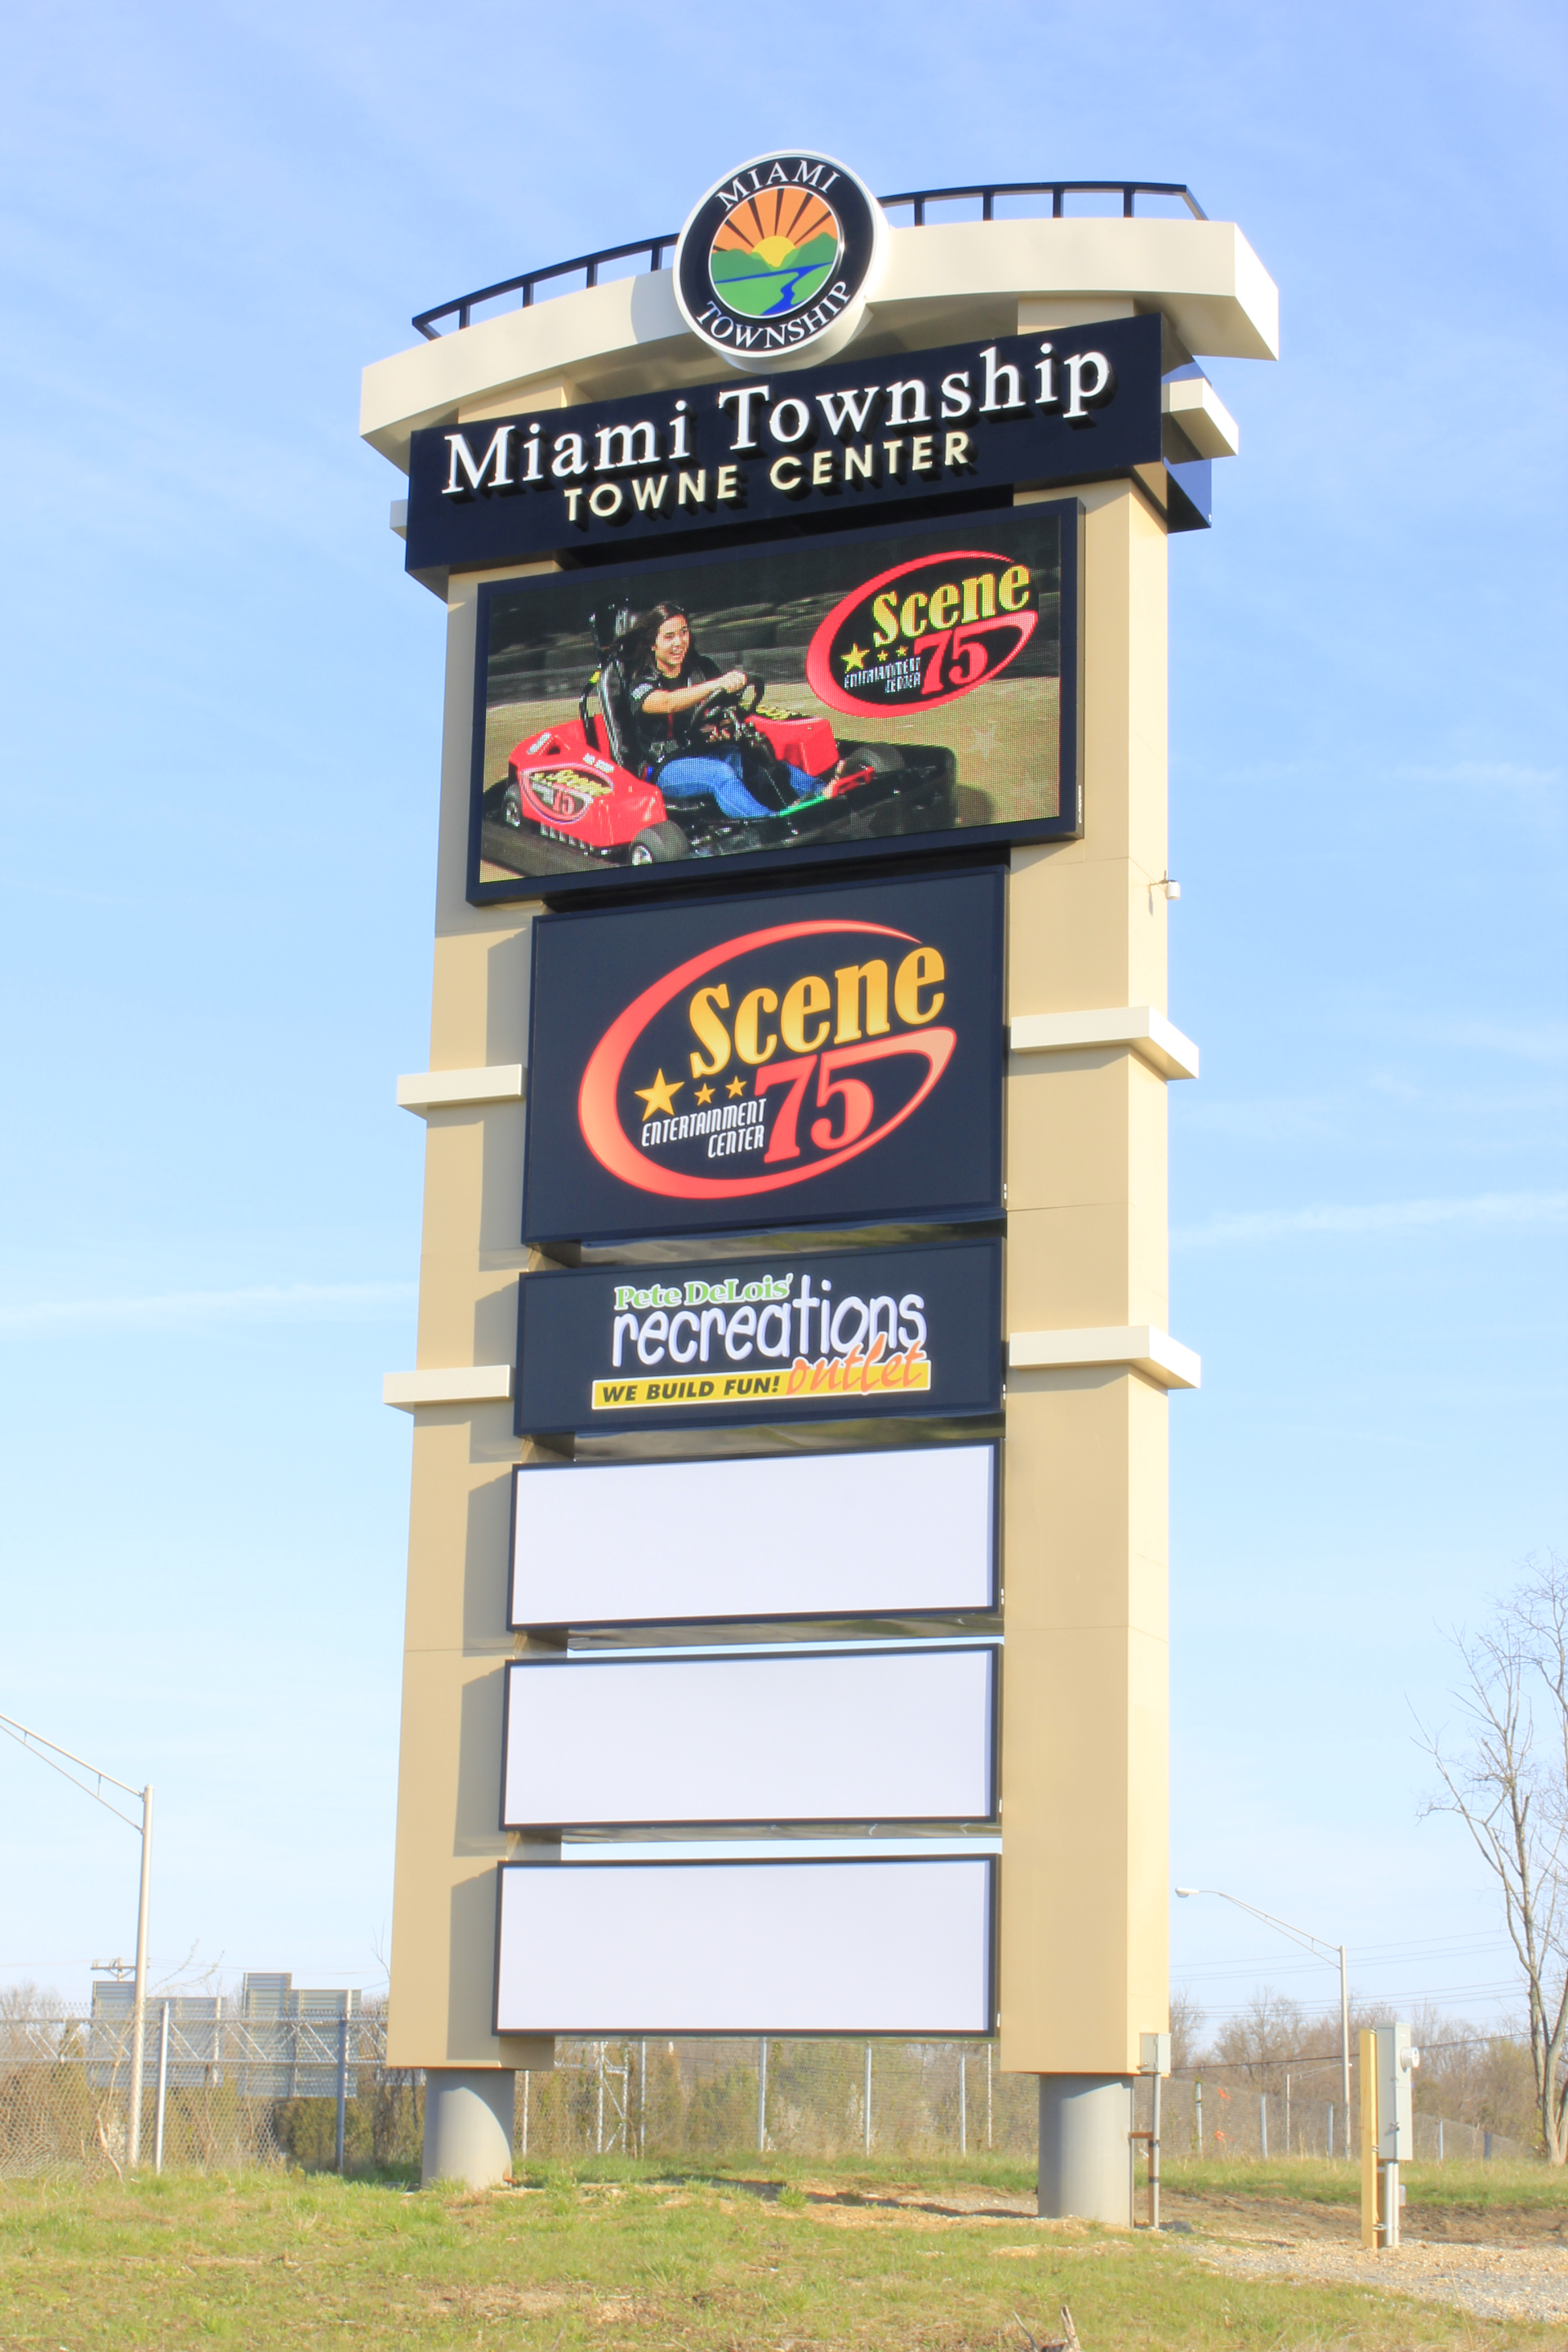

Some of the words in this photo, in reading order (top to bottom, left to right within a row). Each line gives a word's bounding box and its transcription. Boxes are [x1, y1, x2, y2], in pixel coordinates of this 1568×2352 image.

[715, 159, 840, 212] MIAMI
[695, 280, 851, 349] TOWNSHIP
[442, 400, 690, 494] Miami
[719, 347, 1109, 451] Township
[564, 465, 737, 521] TOWNE
[769, 430, 969, 491] CENTER
[872, 564, 1031, 648] Scene
[913, 610, 1039, 695] 75
[688, 947, 946, 1079] Scene
[641, 1098, 767, 1147] ENTERTAINMENT
[754, 1026, 957, 1164] 75
[707, 1124, 765, 1159] CENTER
[612, 1274, 928, 1367] recreations
[614, 1285, 682, 1310] Pete
[603, 1385, 637, 1402] WE
[646, 1380, 714, 1400] BUILD
[724, 1376, 780, 1396] FUN!
[786, 1331, 928, 1396] outlet
